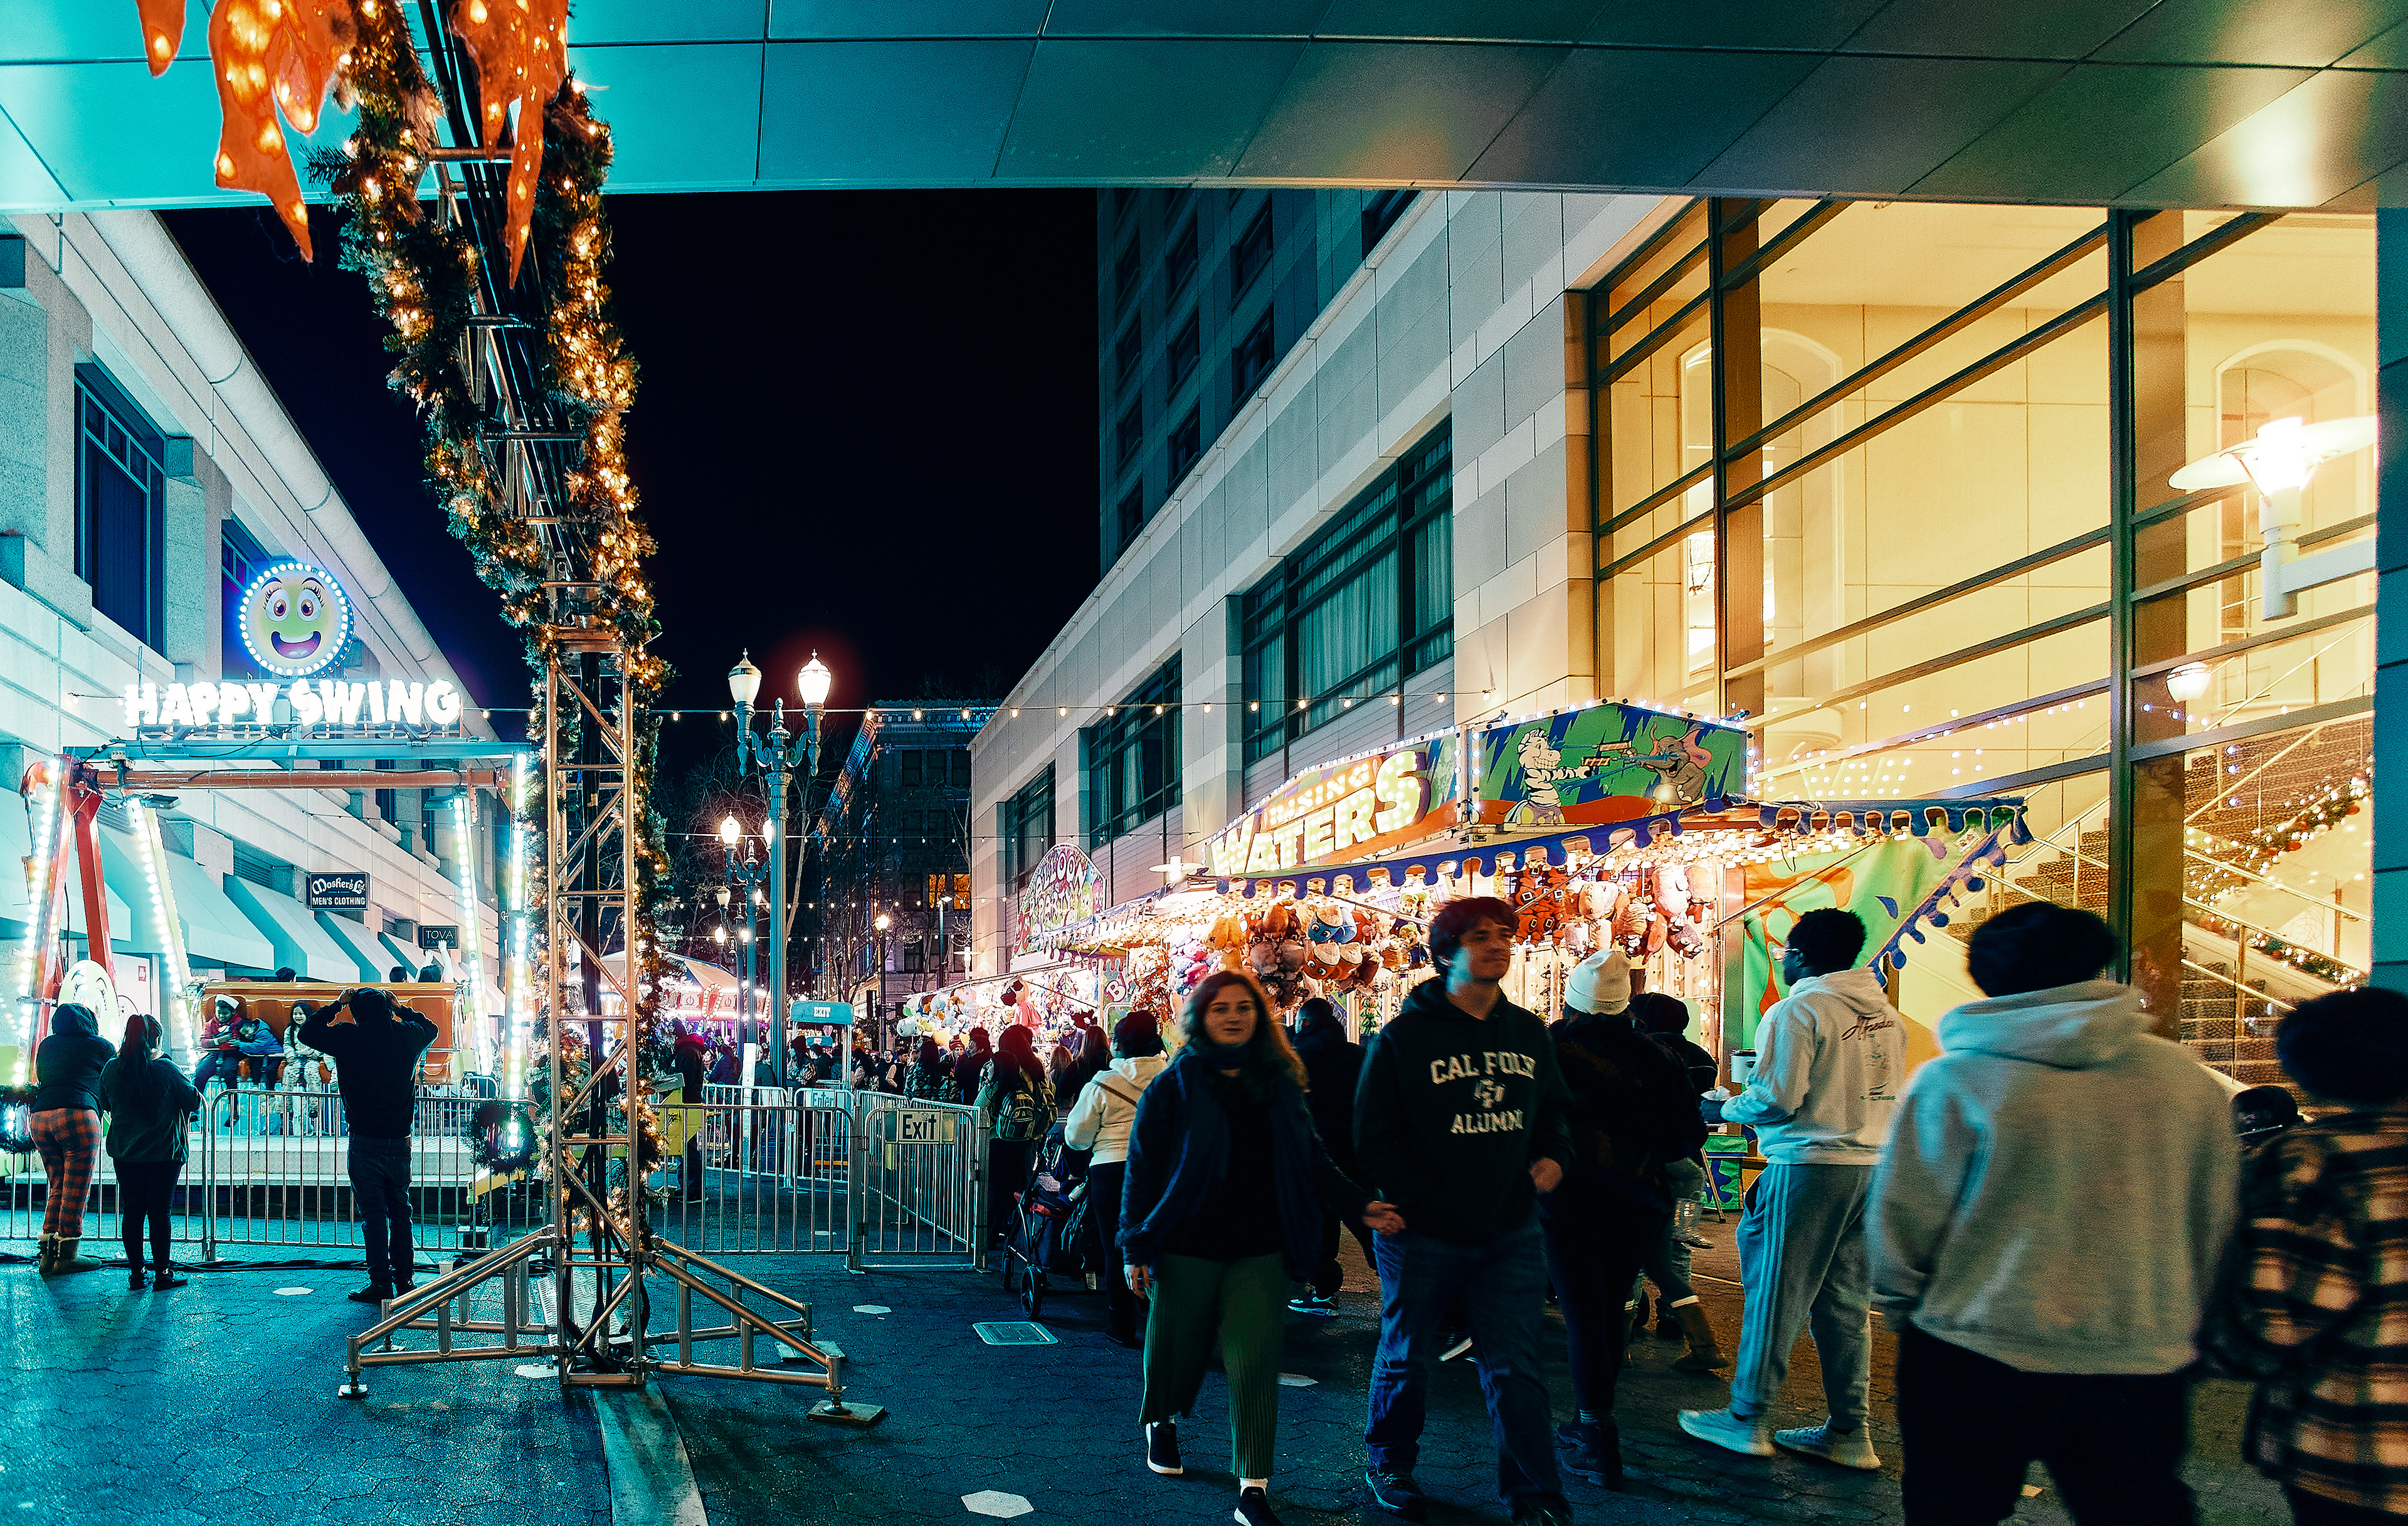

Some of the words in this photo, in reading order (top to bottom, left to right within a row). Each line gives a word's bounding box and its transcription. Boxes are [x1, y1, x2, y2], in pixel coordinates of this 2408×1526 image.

[125, 681, 280, 728] HAPPY
[288, 678, 462, 726] SWING
[1210, 750, 1427, 877] WATERS
[1028, 852, 1087, 917] BALLOON
[312, 897, 332, 905] MEN'S
[334, 897, 366, 905] CLOTHING
[1038, 881, 1074, 923] PARTY
[425, 930, 453, 939] TOVA
[813, 1006, 832, 1018] EXIT
[1430, 1054, 1481, 1084] CAL
[812, 1091, 835, 1107] Enter
[902, 1113, 937, 1140] Exit
